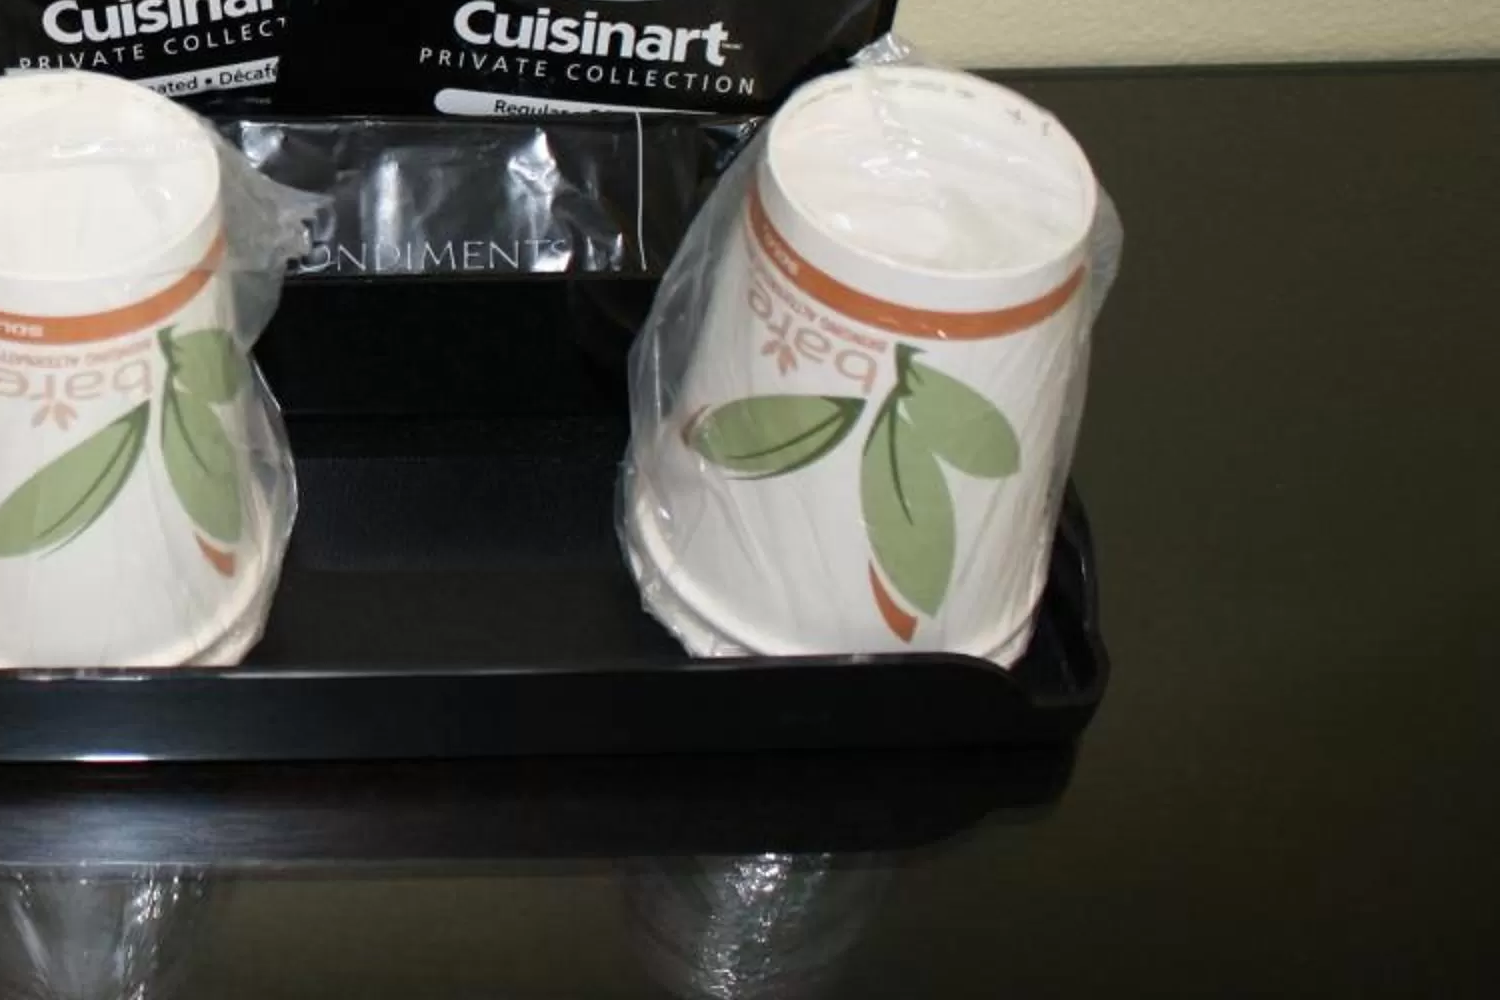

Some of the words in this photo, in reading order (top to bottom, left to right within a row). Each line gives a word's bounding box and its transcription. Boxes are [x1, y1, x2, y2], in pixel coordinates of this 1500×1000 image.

[19, 43, 145, 70] PRIVATE
[418, 47, 549, 78] PRIVATE
[566, 62, 756, 96] COLLECTION
[746, 267, 878, 397] bare
